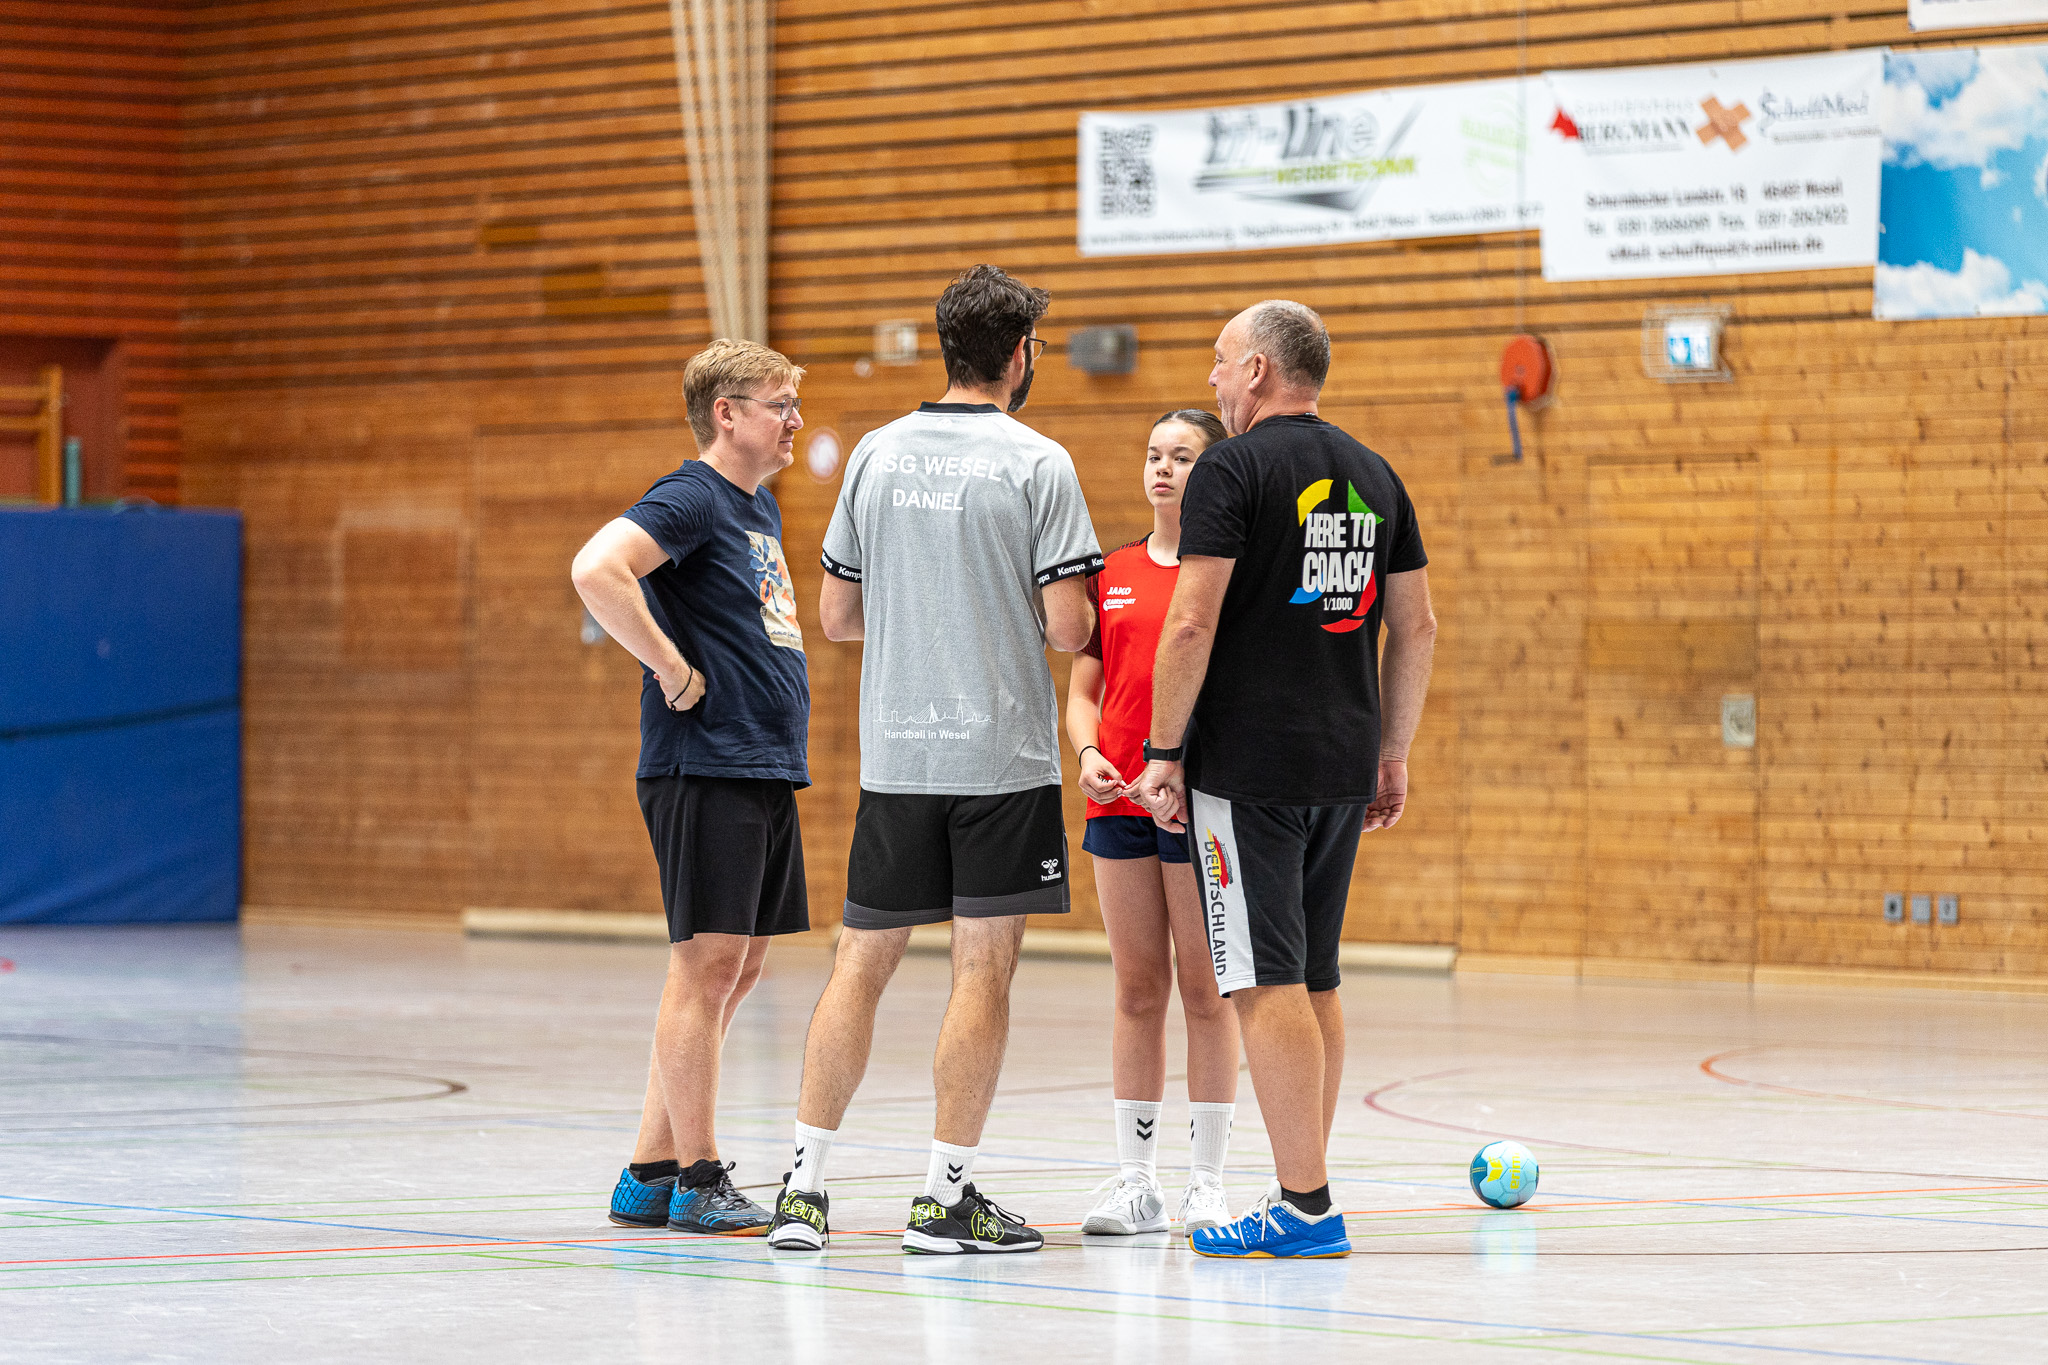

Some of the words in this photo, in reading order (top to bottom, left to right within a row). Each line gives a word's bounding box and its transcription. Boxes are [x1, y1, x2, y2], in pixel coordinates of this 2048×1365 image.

[924, 455, 1002, 482] WESEL
[892, 488, 964, 511] DANIEL
[1350, 512, 1376, 548] TO
[1057, 563, 1086, 576] Kempa
[1302, 551, 1375, 593] COACH
[1106, 586, 1132, 595] JAKO
[1323, 597, 1353, 611] 1/1000
[884, 729, 926, 739] Handball
[928, 729, 937, 739] in
[939, 729, 970, 740] Wesel
[1204, 841, 1226, 976] DEUTSCHLAND
